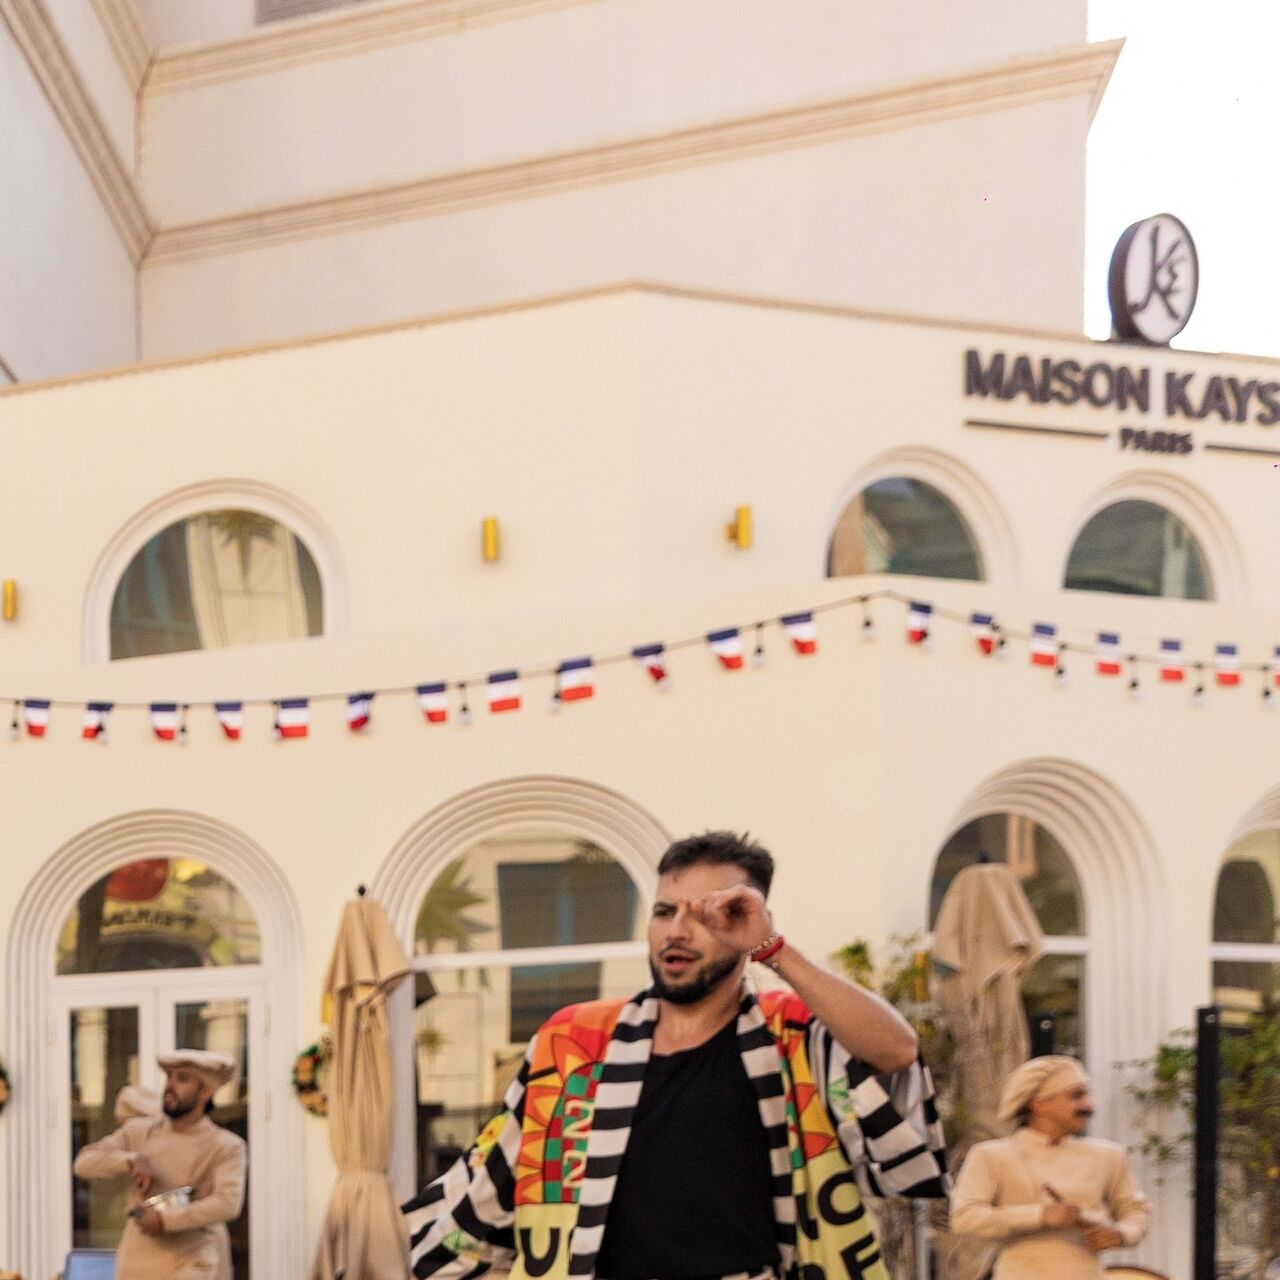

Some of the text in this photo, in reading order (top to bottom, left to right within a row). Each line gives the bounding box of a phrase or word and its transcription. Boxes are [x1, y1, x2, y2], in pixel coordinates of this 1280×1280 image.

[965, 349, 1280, 425] MAISON KAYS
[1120, 427, 1193, 455] PARIS
